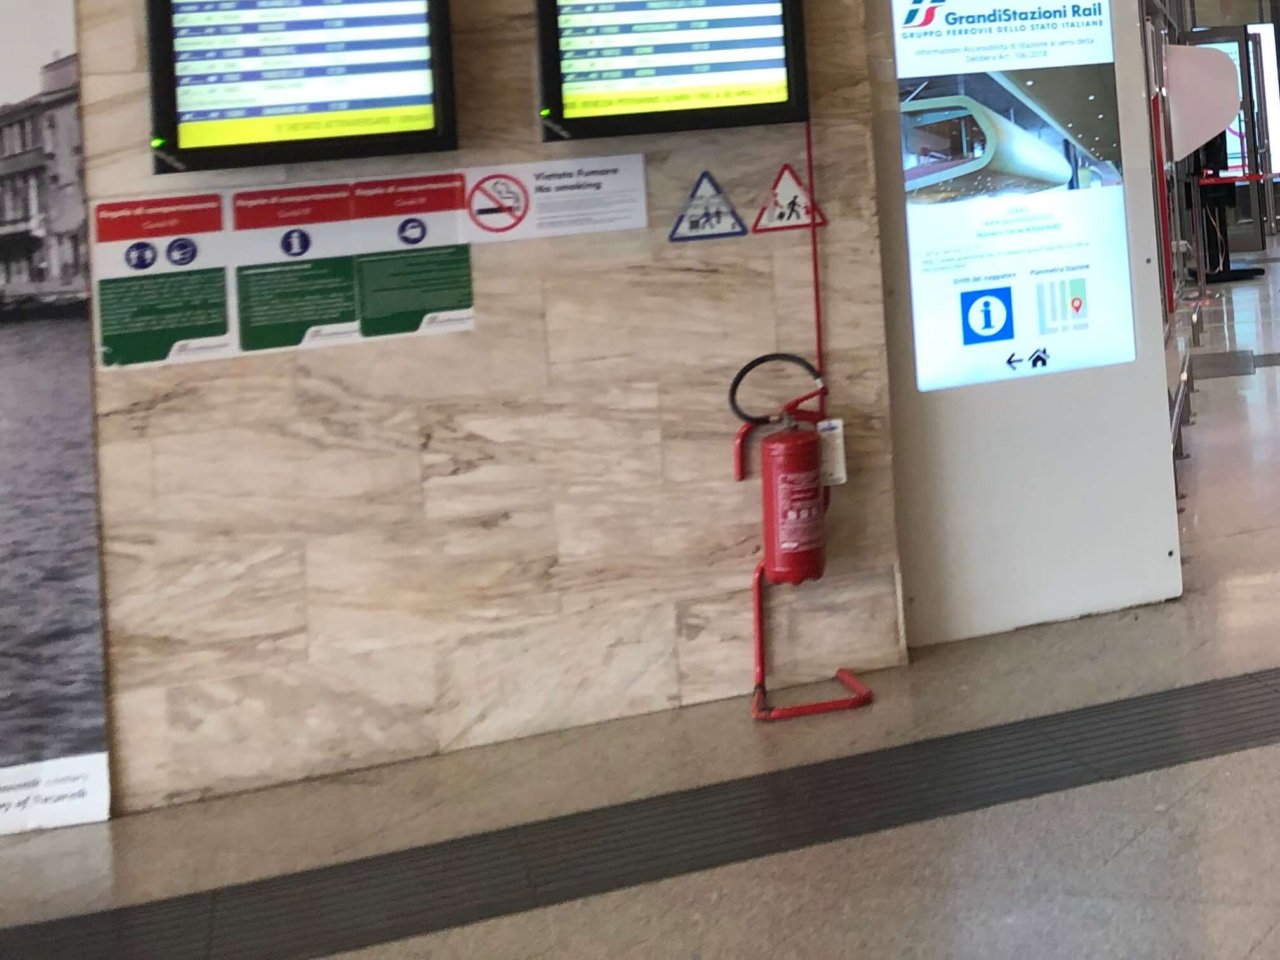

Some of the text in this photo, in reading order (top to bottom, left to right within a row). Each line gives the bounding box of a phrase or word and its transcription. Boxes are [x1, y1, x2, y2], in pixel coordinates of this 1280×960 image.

[945, 2, 1102, 26] GrandiStazioni Rail
[901, 19, 1104, 40] GRUPPO FERROVIE DELLO STATO ITALIANE
[534, 172, 573, 181] Vietato
[535, 182, 602, 193] No smoking
